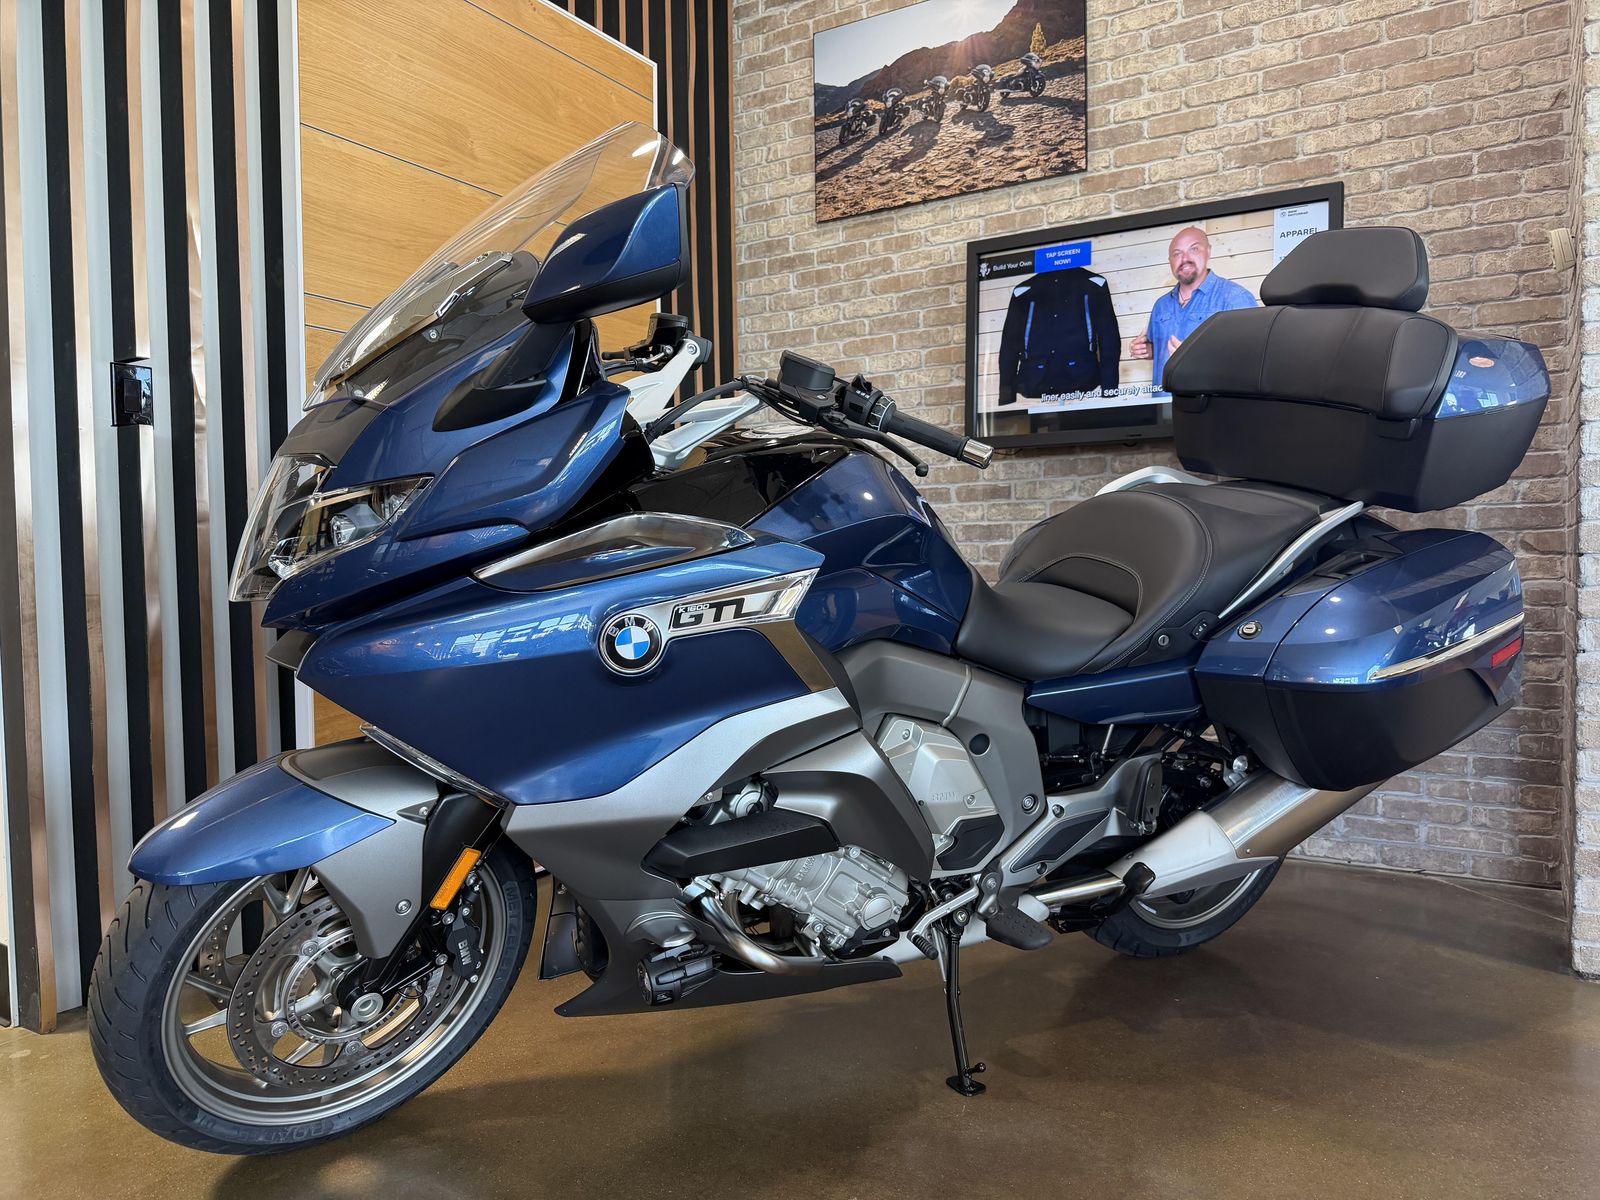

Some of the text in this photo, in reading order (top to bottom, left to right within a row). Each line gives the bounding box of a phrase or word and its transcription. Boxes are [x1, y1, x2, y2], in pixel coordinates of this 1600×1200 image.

[1280, 227, 1318, 238] APPAREL
[1057, 248, 1081, 257] SCREEN
[1054, 258, 1072, 266] NOW!
[1041, 393, 1059, 403] liner
[1060, 391, 1085, 402] easily
[1086, 388, 1102, 398] and
[1103, 385, 1140, 398] securely
[672, 597, 764, 629] GTL
[687, 603, 709, 612] 1600
[458, 939, 472, 966] BMW
